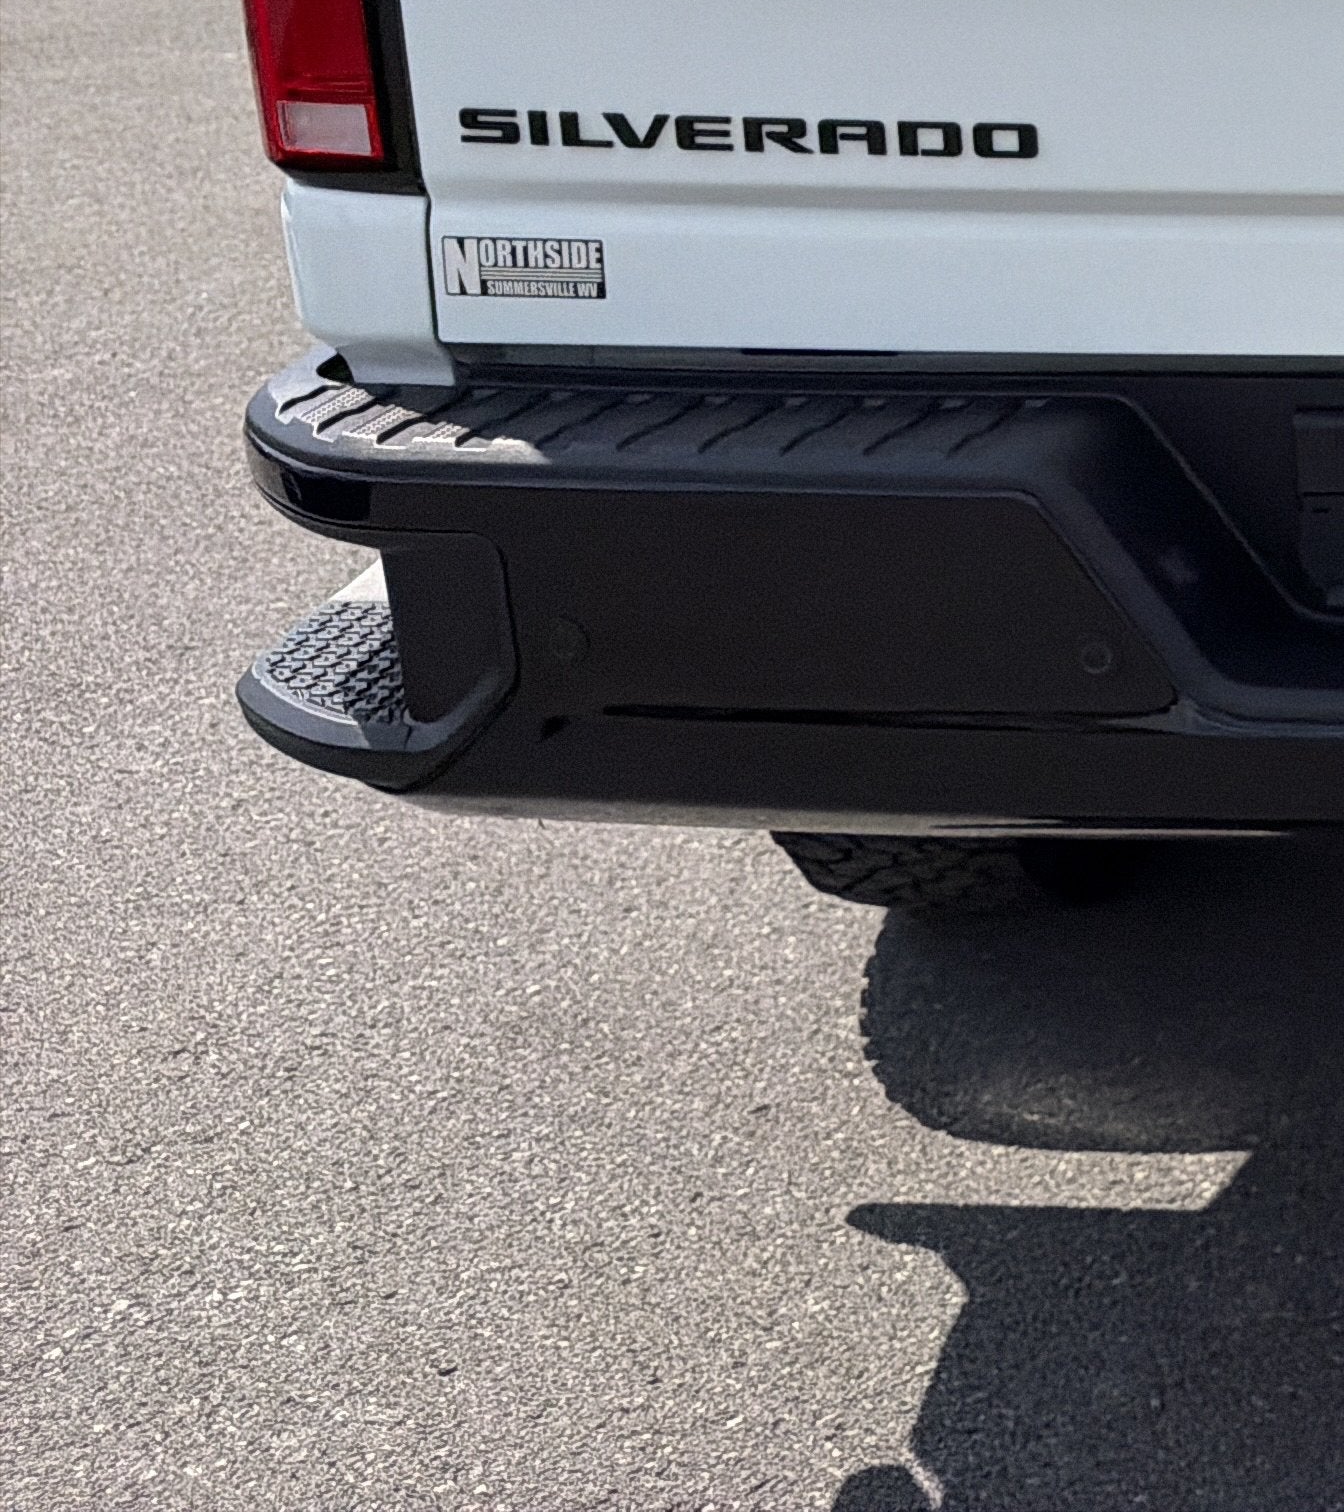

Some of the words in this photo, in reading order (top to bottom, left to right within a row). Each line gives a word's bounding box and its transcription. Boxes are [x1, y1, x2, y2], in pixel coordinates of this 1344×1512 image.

[458, 106, 1040, 159] SILVERADO
[443, 237, 603, 295] NORTHSIDE
[486, 280, 576, 296] SUMMERSVILLE
[577, 282, 598, 298] WV
